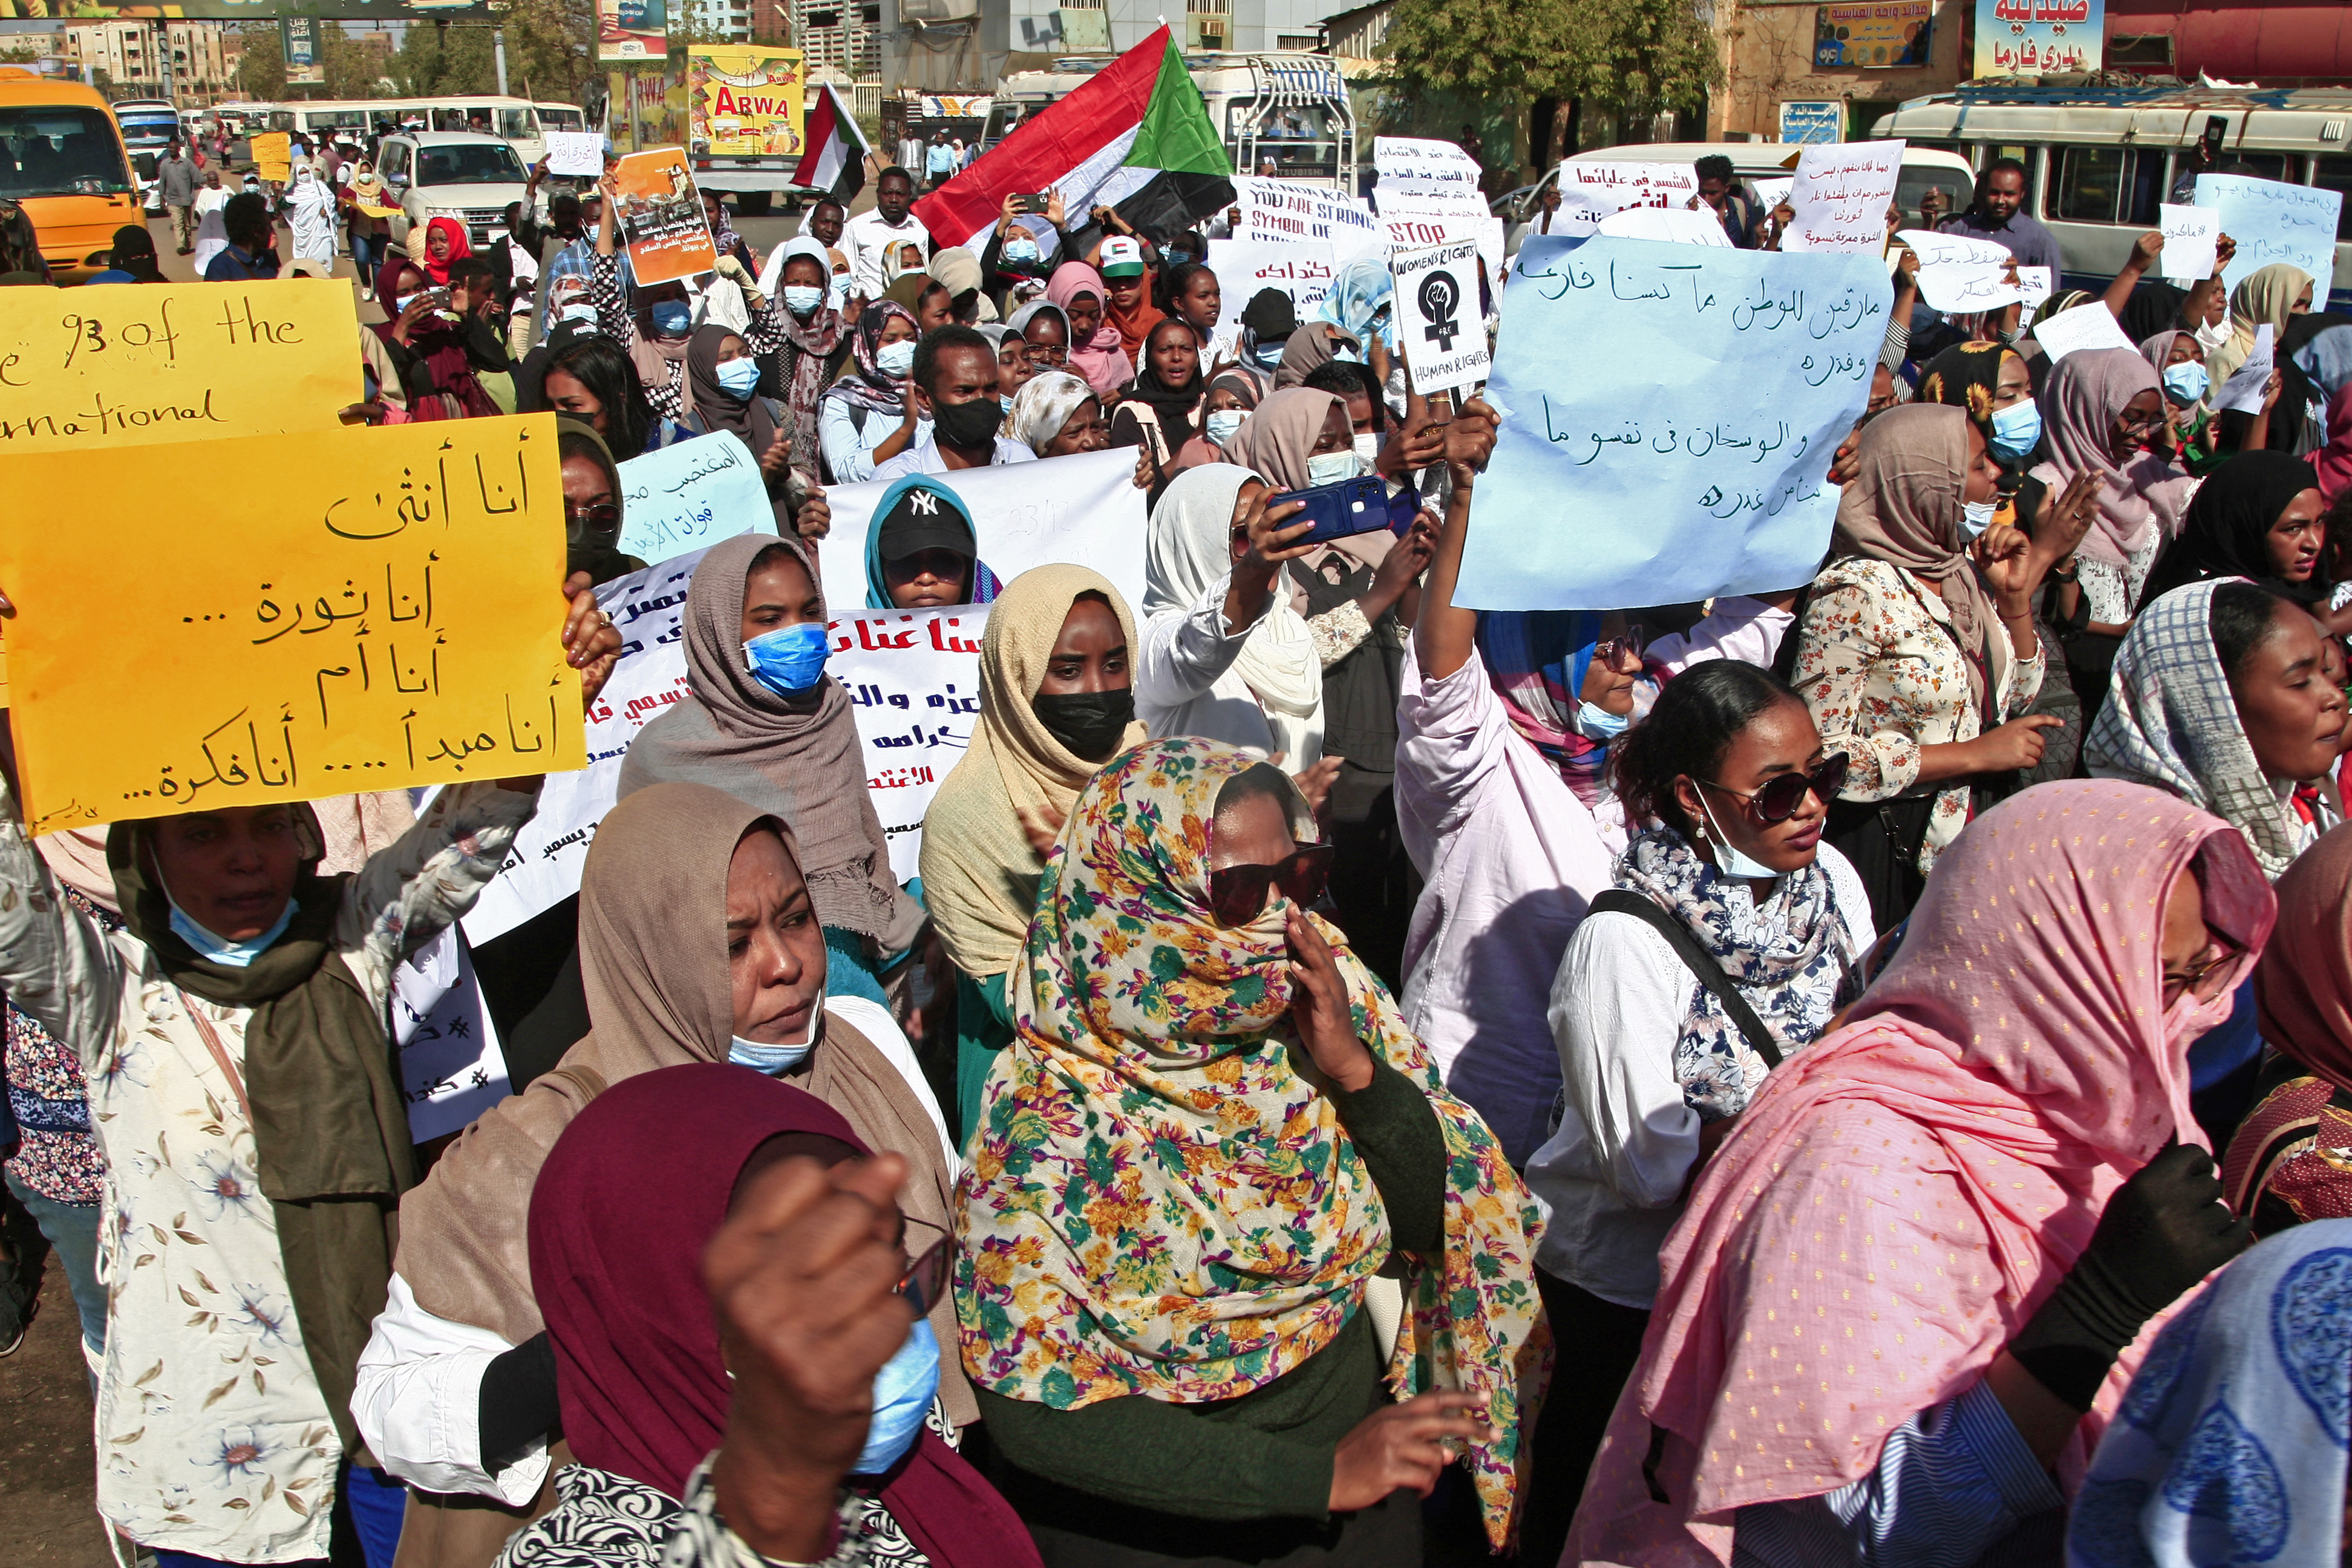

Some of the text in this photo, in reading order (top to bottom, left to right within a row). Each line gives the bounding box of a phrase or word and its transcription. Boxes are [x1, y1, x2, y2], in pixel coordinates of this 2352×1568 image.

[1832, 6, 1872, 22] العباسية
[1875, 5, 1900, 20] واحة
[1994, 37, 2037, 73] فارما
[768, 74, 795, 83] ARWA
[714, 86, 789, 119] ARWA
[1653, 167, 1691, 189] الشمس
[1809, 166, 1836, 180] ليس
[1877, 161, 1889, 174] مهما
[686, 216, 703, 226] الليلة
[1249, 188, 1284, 208] YOU
[1287, 195, 1313, 215] ARE
[1316, 203, 1376, 232] STRONG
[1252, 210, 1308, 236] SYMBOL
[1312, 222, 1333, 240] OF
[662, 239, 682, 250] بنفس
[675, 227, 694, 238] الشارع
[1386, 221, 1446, 245] STOP
[1804, 229, 1836, 246] نسوية
[1396, 251, 1439, 276] WOMEN'S
[1439, 244, 1475, 266] RIGHTS
[1731, 276, 1804, 331] للوطن
[122, 297, 180, 361] of
[216, 295, 304, 345] the
[572, 325, 598, 336] PUMA
[1414, 351, 1489, 383] HUMAN RIGHTS
[0, 388, 229, 440] rnational
[1541, 393, 1569, 442] ما
[474, 426, 531, 516] أنا
[909, 489, 939, 516] NY
[384, 549, 441, 629] أنا
[251, 578, 370, 645] ثورة
[388, 627, 448, 698] أنا
[504, 662, 563, 758] أنا
[158, 705, 250, 806] فكرة
[247, 701, 299, 789] أنا
[399, 707, 496, 774] مبدأ
